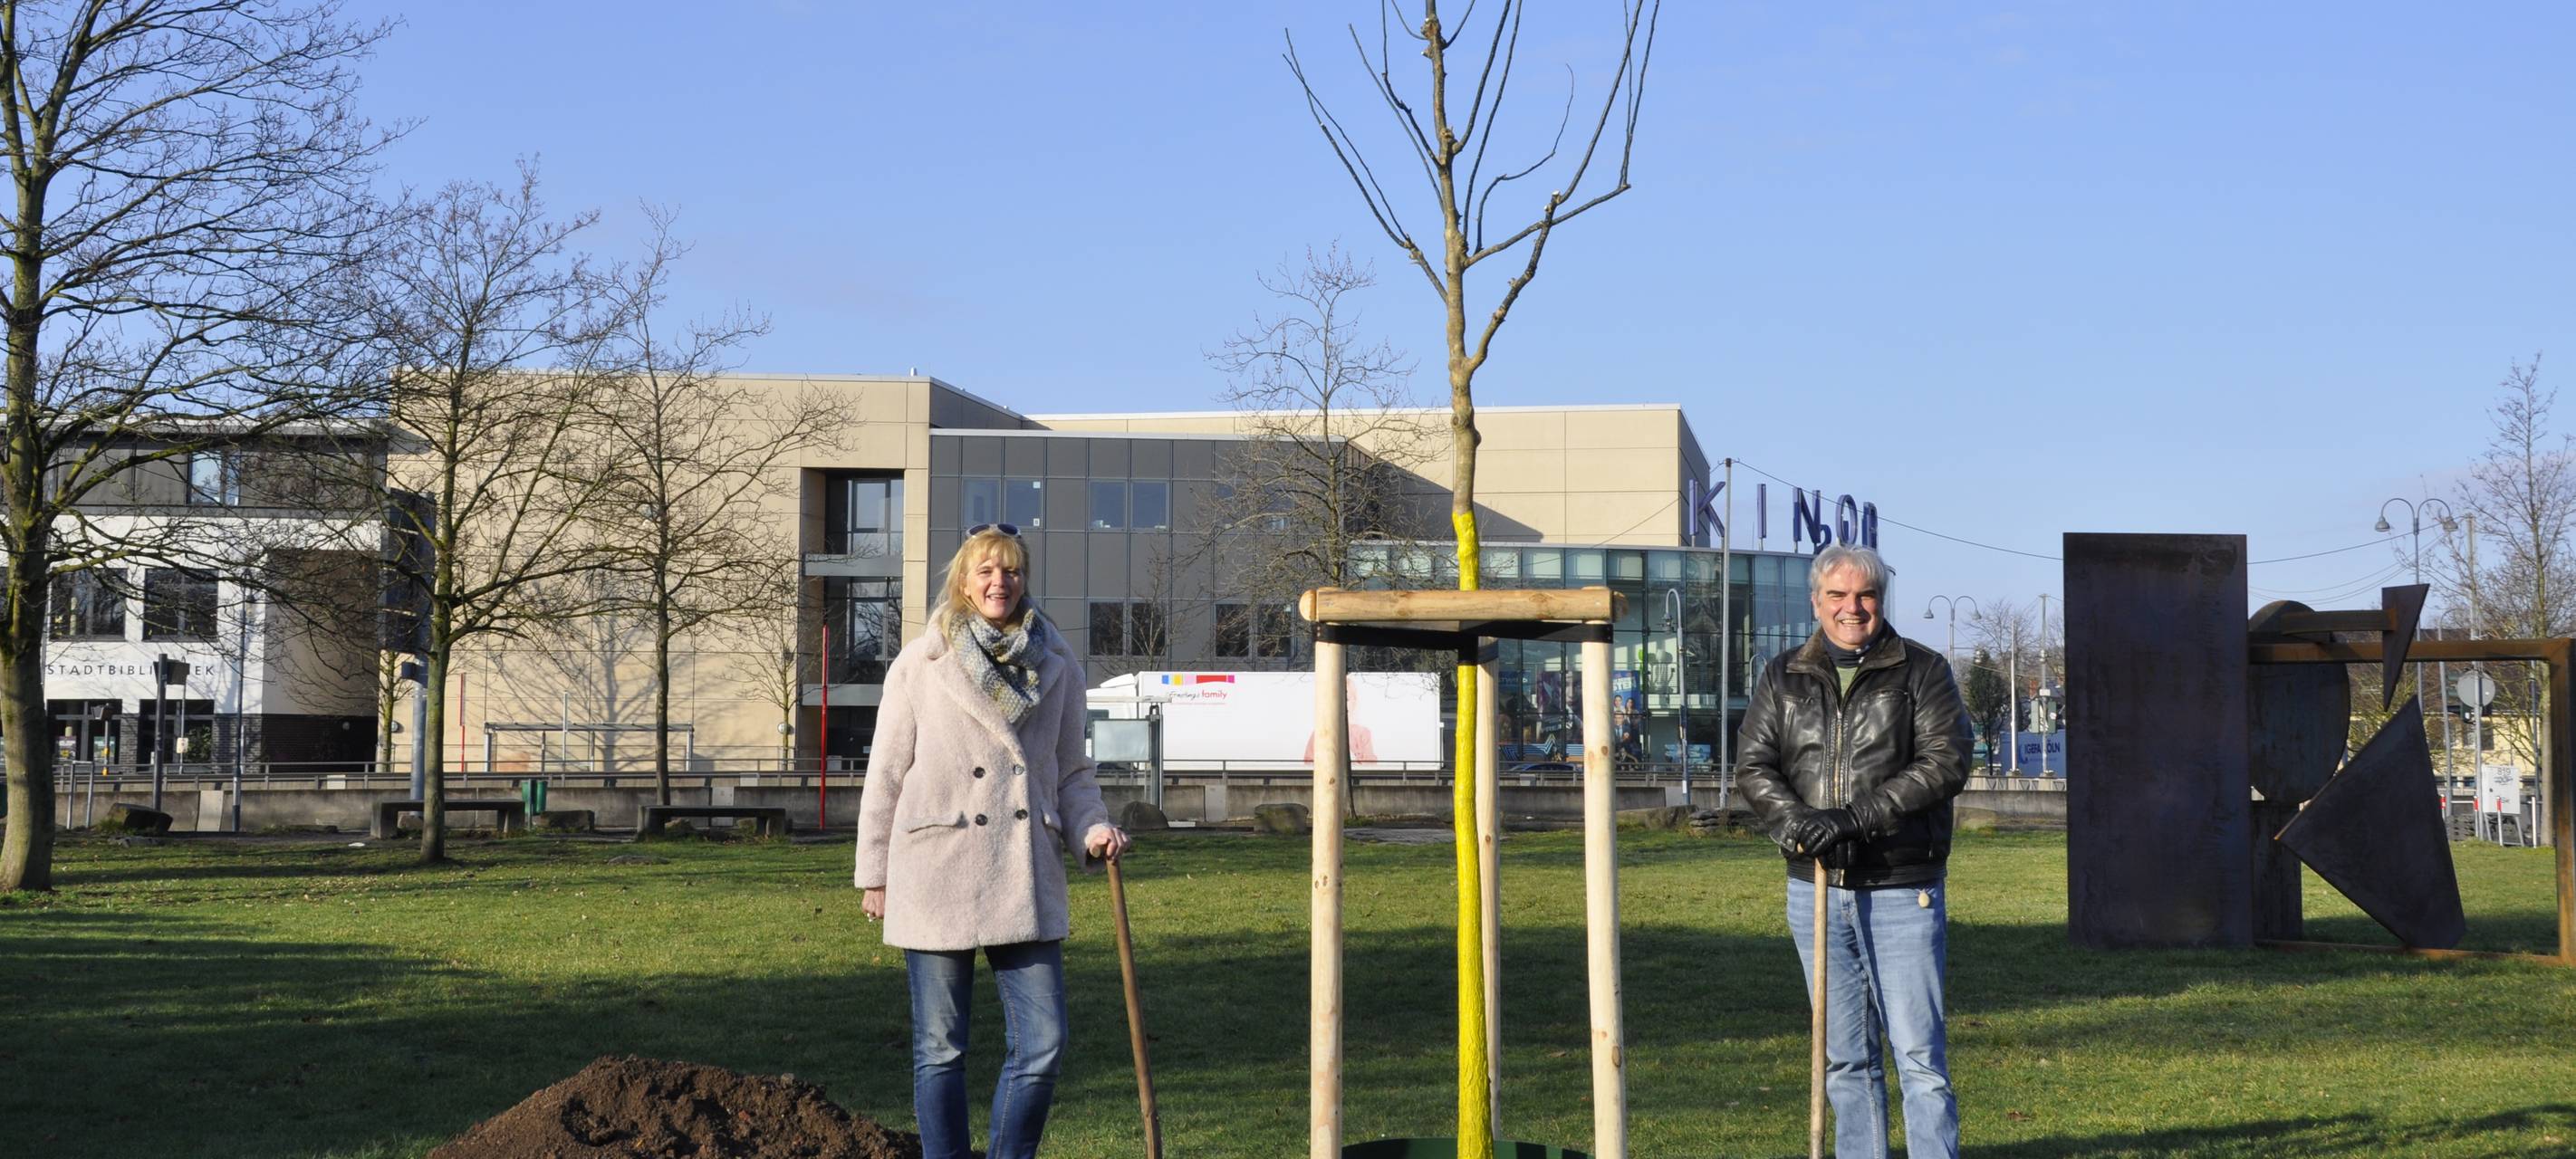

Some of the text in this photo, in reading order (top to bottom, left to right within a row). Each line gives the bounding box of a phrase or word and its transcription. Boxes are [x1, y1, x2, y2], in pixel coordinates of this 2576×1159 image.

[1688, 479, 1859, 545] KINO
[47, 665, 215, 675] STADTBIBLIEK
[1202, 689, 1227, 699] family
[2044, 740, 2060, 753] ÖLN
